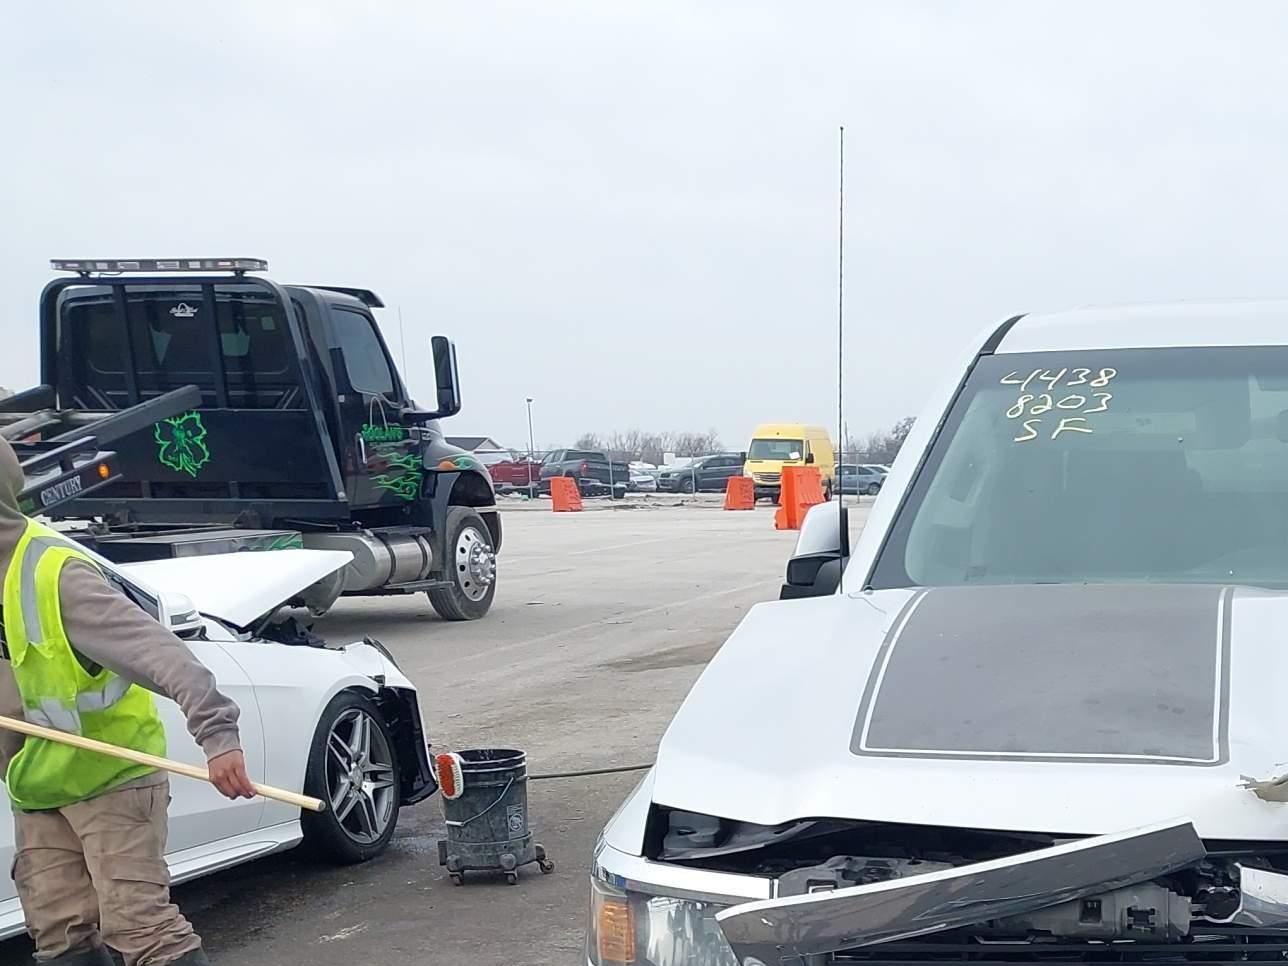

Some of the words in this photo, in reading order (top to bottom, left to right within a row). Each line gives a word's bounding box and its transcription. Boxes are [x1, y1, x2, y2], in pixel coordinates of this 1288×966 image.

[1000, 368, 1117, 391] 4438
[1007, 393, 1113, 418] 8203
[41, 475, 82, 505] CENTURY
